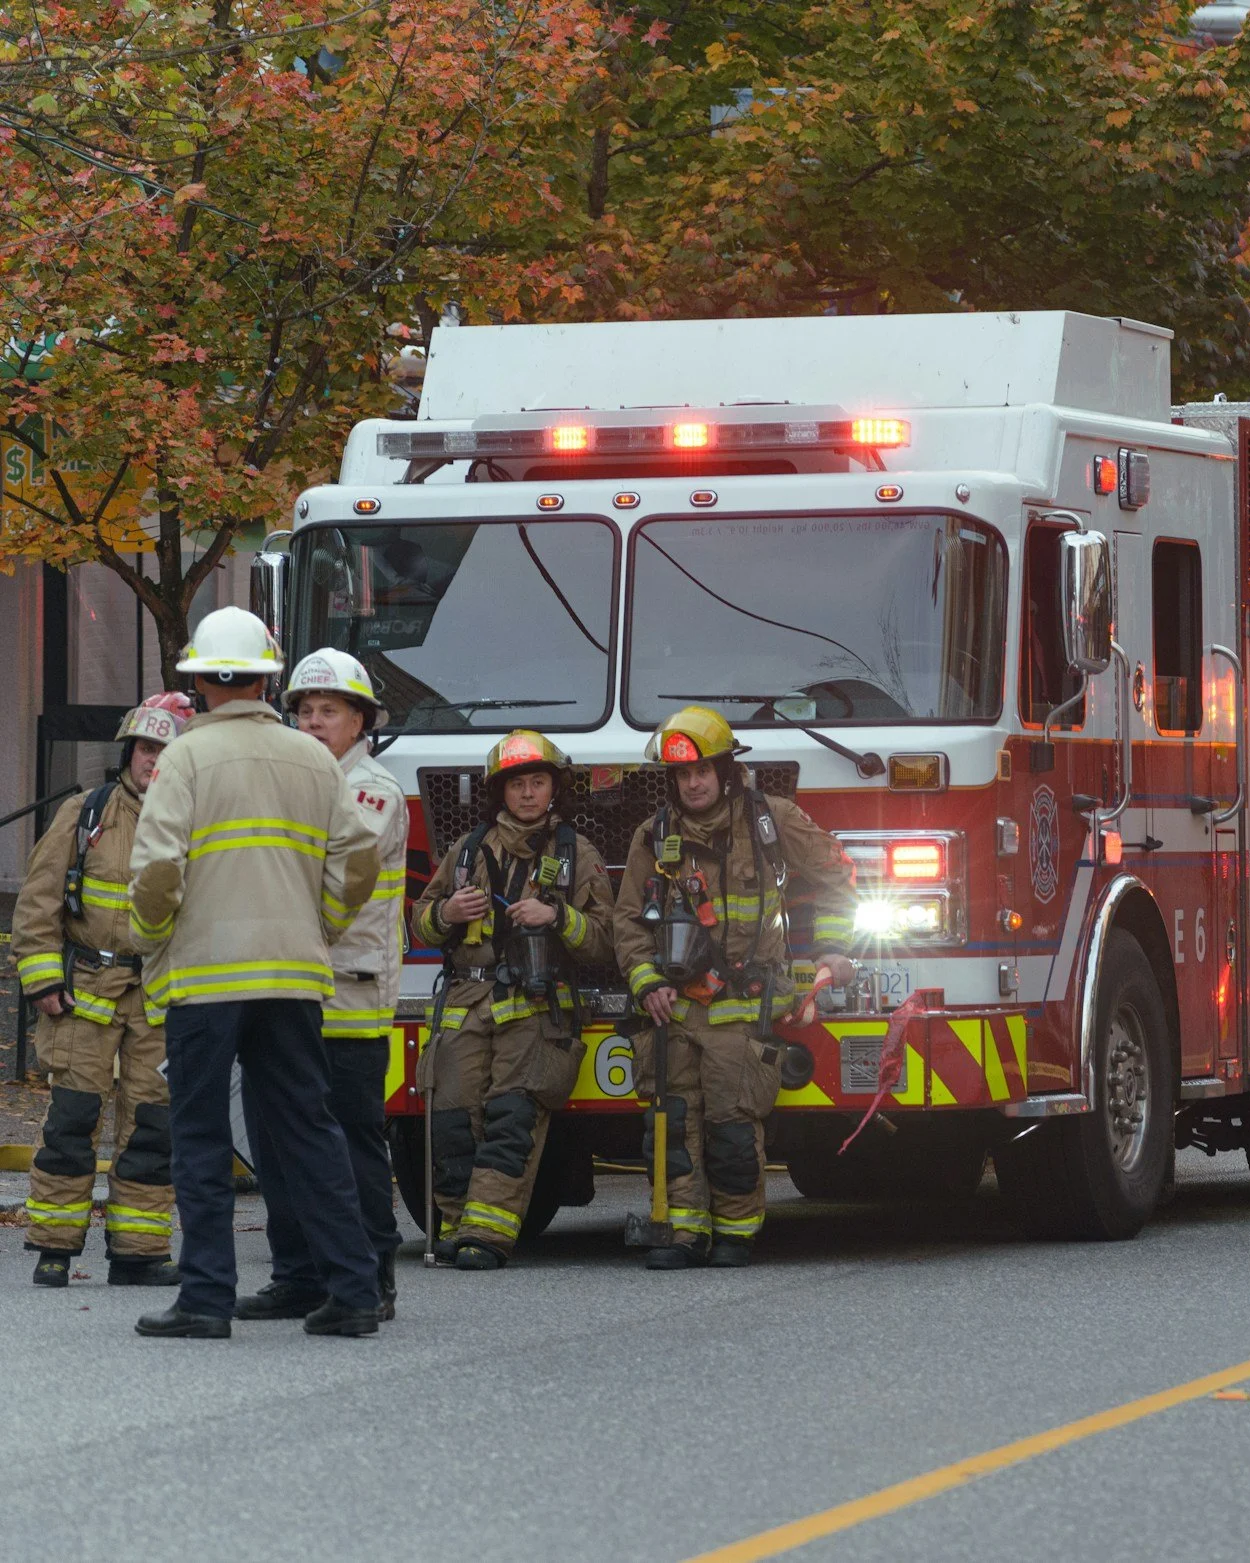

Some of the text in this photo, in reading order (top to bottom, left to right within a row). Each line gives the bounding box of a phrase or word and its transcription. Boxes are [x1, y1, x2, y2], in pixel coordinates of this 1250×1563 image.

[300, 676, 330, 685] CHIEF
[146, 716, 170, 738] R8
[669, 740, 687, 758] R8
[1175, 907, 1206, 964] E 6
[594, 1034, 636, 1097] 6
